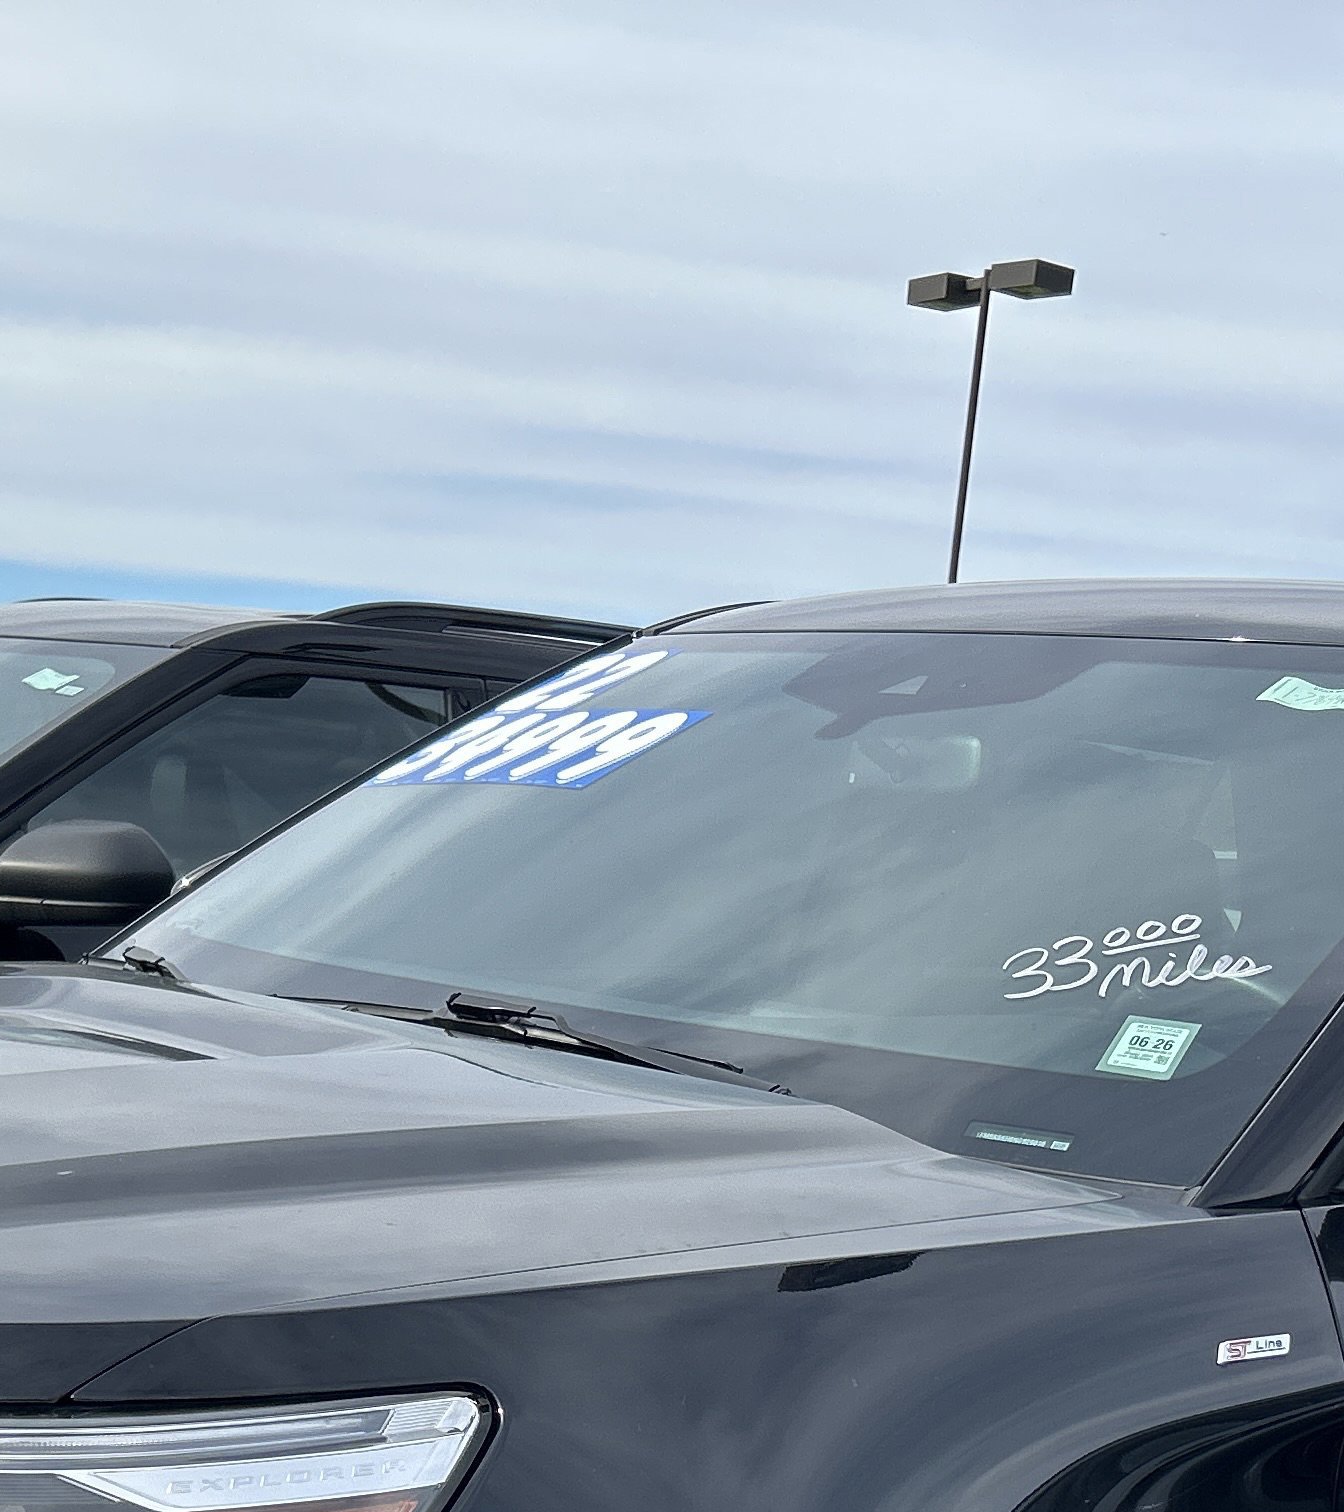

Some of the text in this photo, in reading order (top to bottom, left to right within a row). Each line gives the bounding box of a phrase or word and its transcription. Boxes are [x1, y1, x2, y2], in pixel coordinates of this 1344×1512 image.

[494, 650, 669, 714] 22
[373, 710, 689, 784] 34999
[1002, 935, 1099, 999] 33
[1098, 943, 1273, 998] miles
[1129, 1035, 1175, 1051] 06 26
[165, 1458, 408, 1495] EXPLORER
